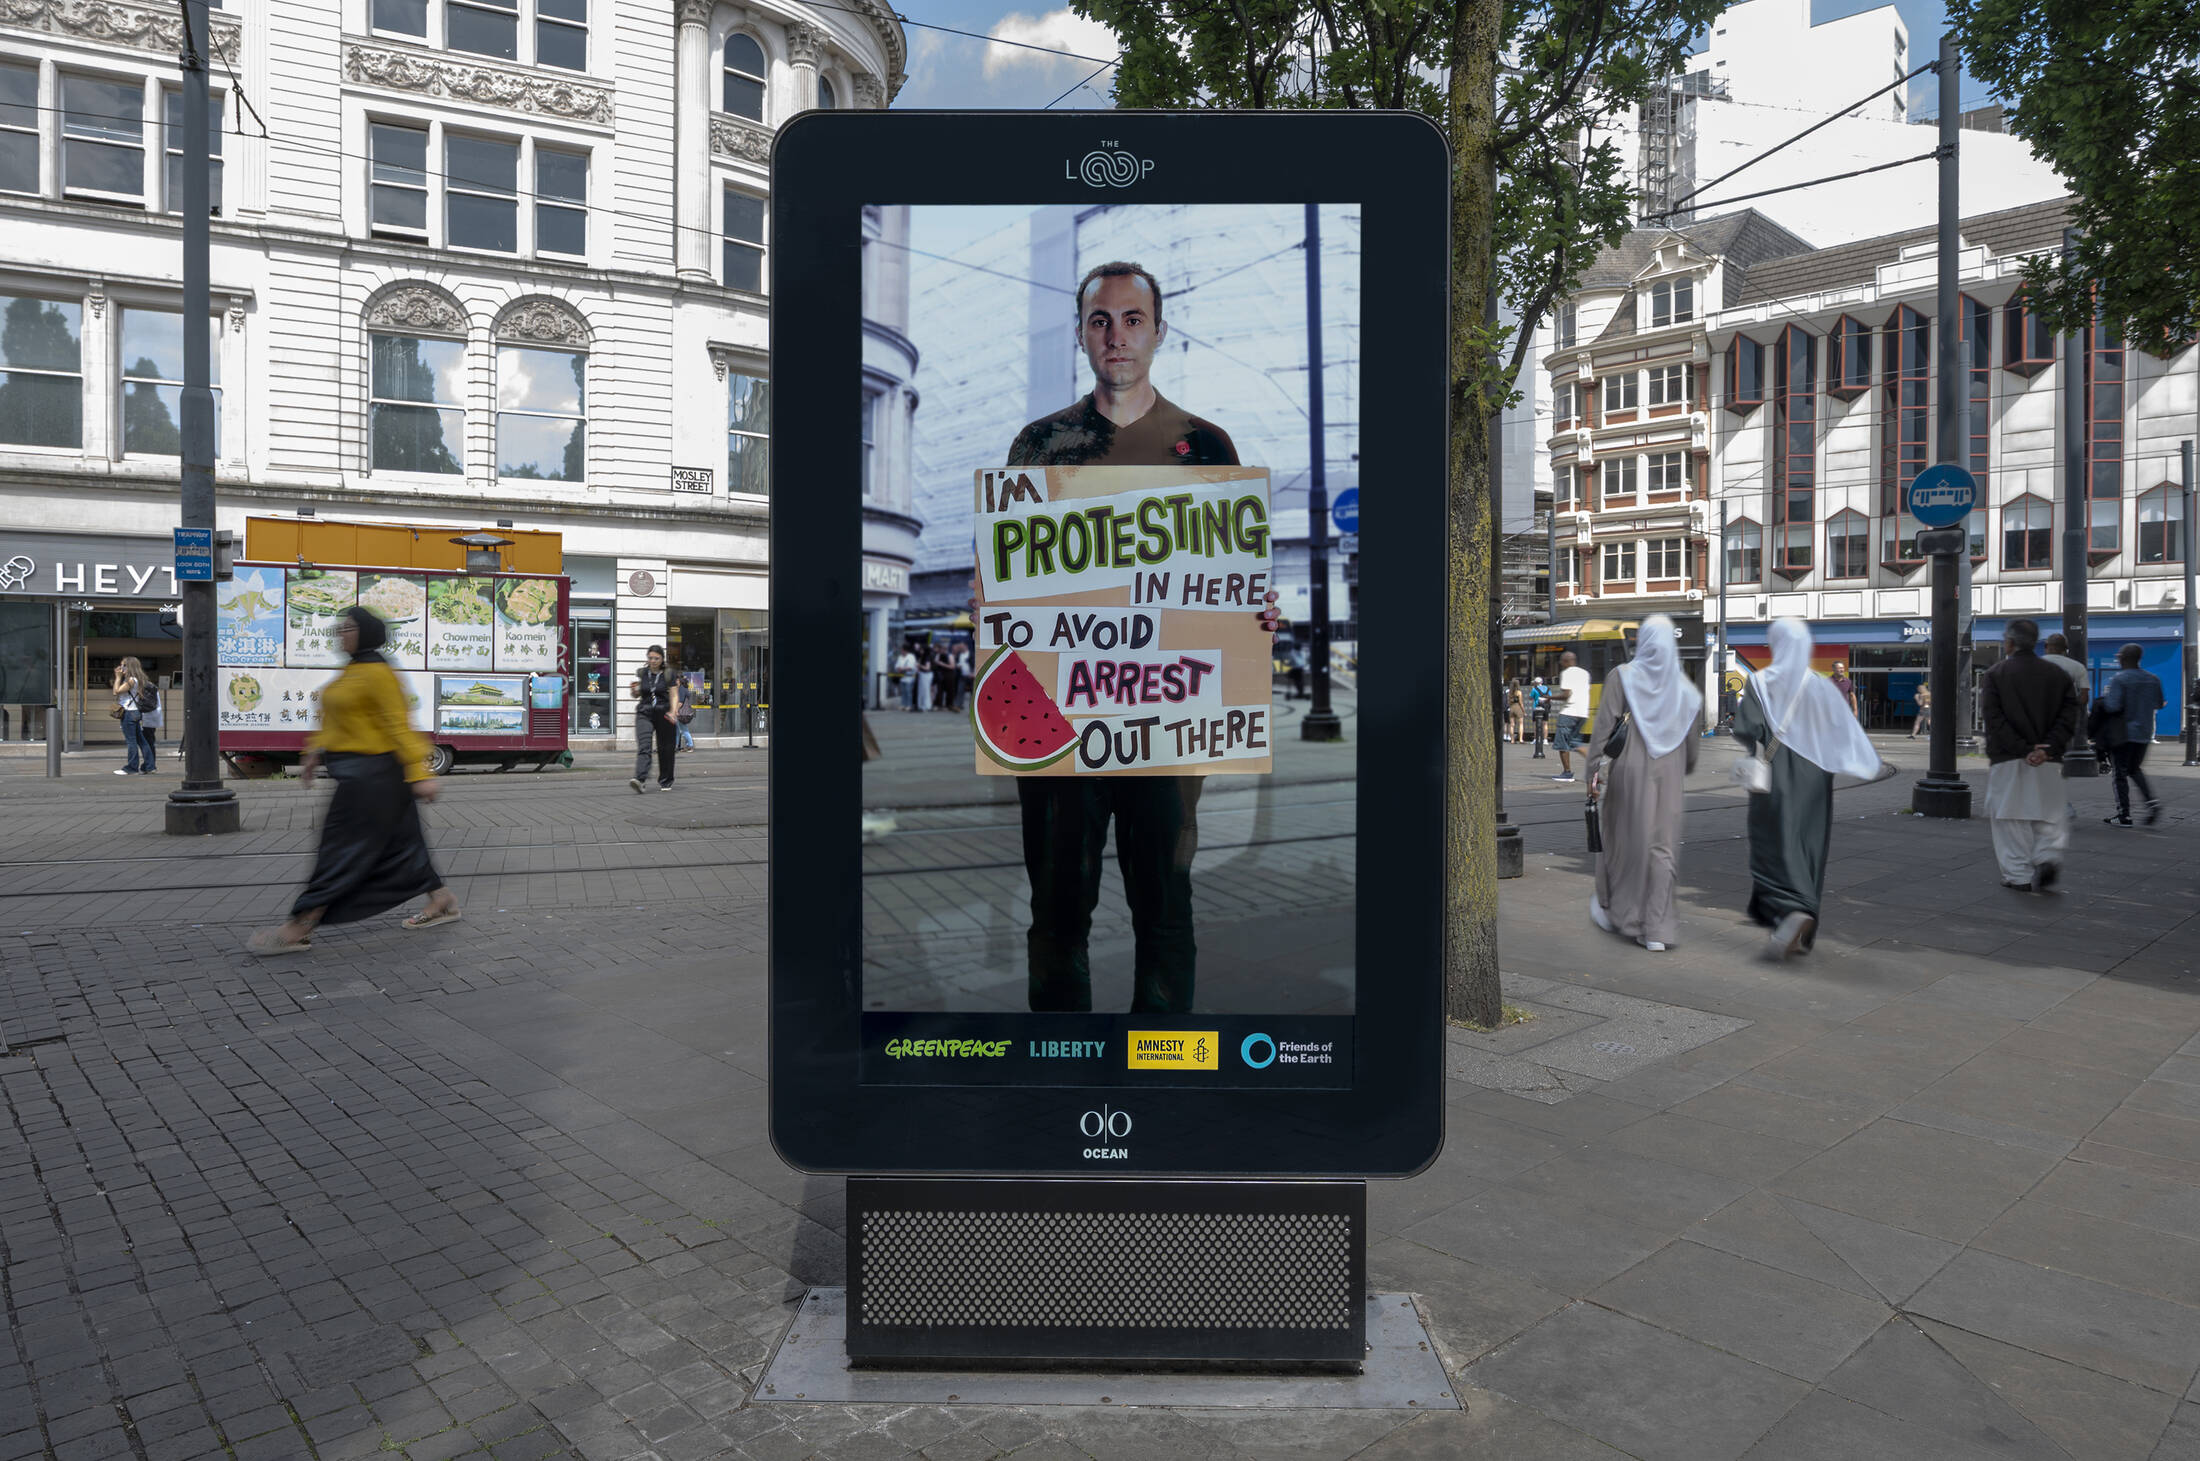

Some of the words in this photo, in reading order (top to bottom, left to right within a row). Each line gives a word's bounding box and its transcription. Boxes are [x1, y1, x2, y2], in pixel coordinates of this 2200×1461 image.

[674, 470, 711, 482] MOSLEY
[675, 480, 710, 491] STREET
[985, 471, 1043, 513] I'M
[993, 493, 1270, 583] PROTESTING
[1135, 572, 1170, 604] IN
[1181, 573, 1267, 606] HERE
[442, 632, 469, 642] Chow
[469, 633, 492, 642] mein
[505, 631, 523, 641] Kao
[524, 632, 546, 641] mein
[984, 612, 1033, 648] TO
[1050, 612, 1154, 650] AVOID
[221, 654, 239, 663] Ice
[240, 655, 275, 663] cream
[1065, 656, 1215, 708] ARREST
[1079, 716, 1160, 769] OUT
[1164, 709, 1267, 758] THERE
[885, 1038, 1012, 1060] GREENPEACE
[1029, 1040, 1106, 1058] LIBERTY
[1136, 1040, 1185, 1052] AMNESTY
[1279, 1041, 1320, 1052] Friends
[1322, 1041, 1333, 1052] of
[1136, 1053, 1185, 1061] INTERNATIONAL
[1279, 1053, 1298, 1063] the
[1300, 1053, 1333, 1064] Earth
[1083, 1148, 1128, 1159] OCEAN
